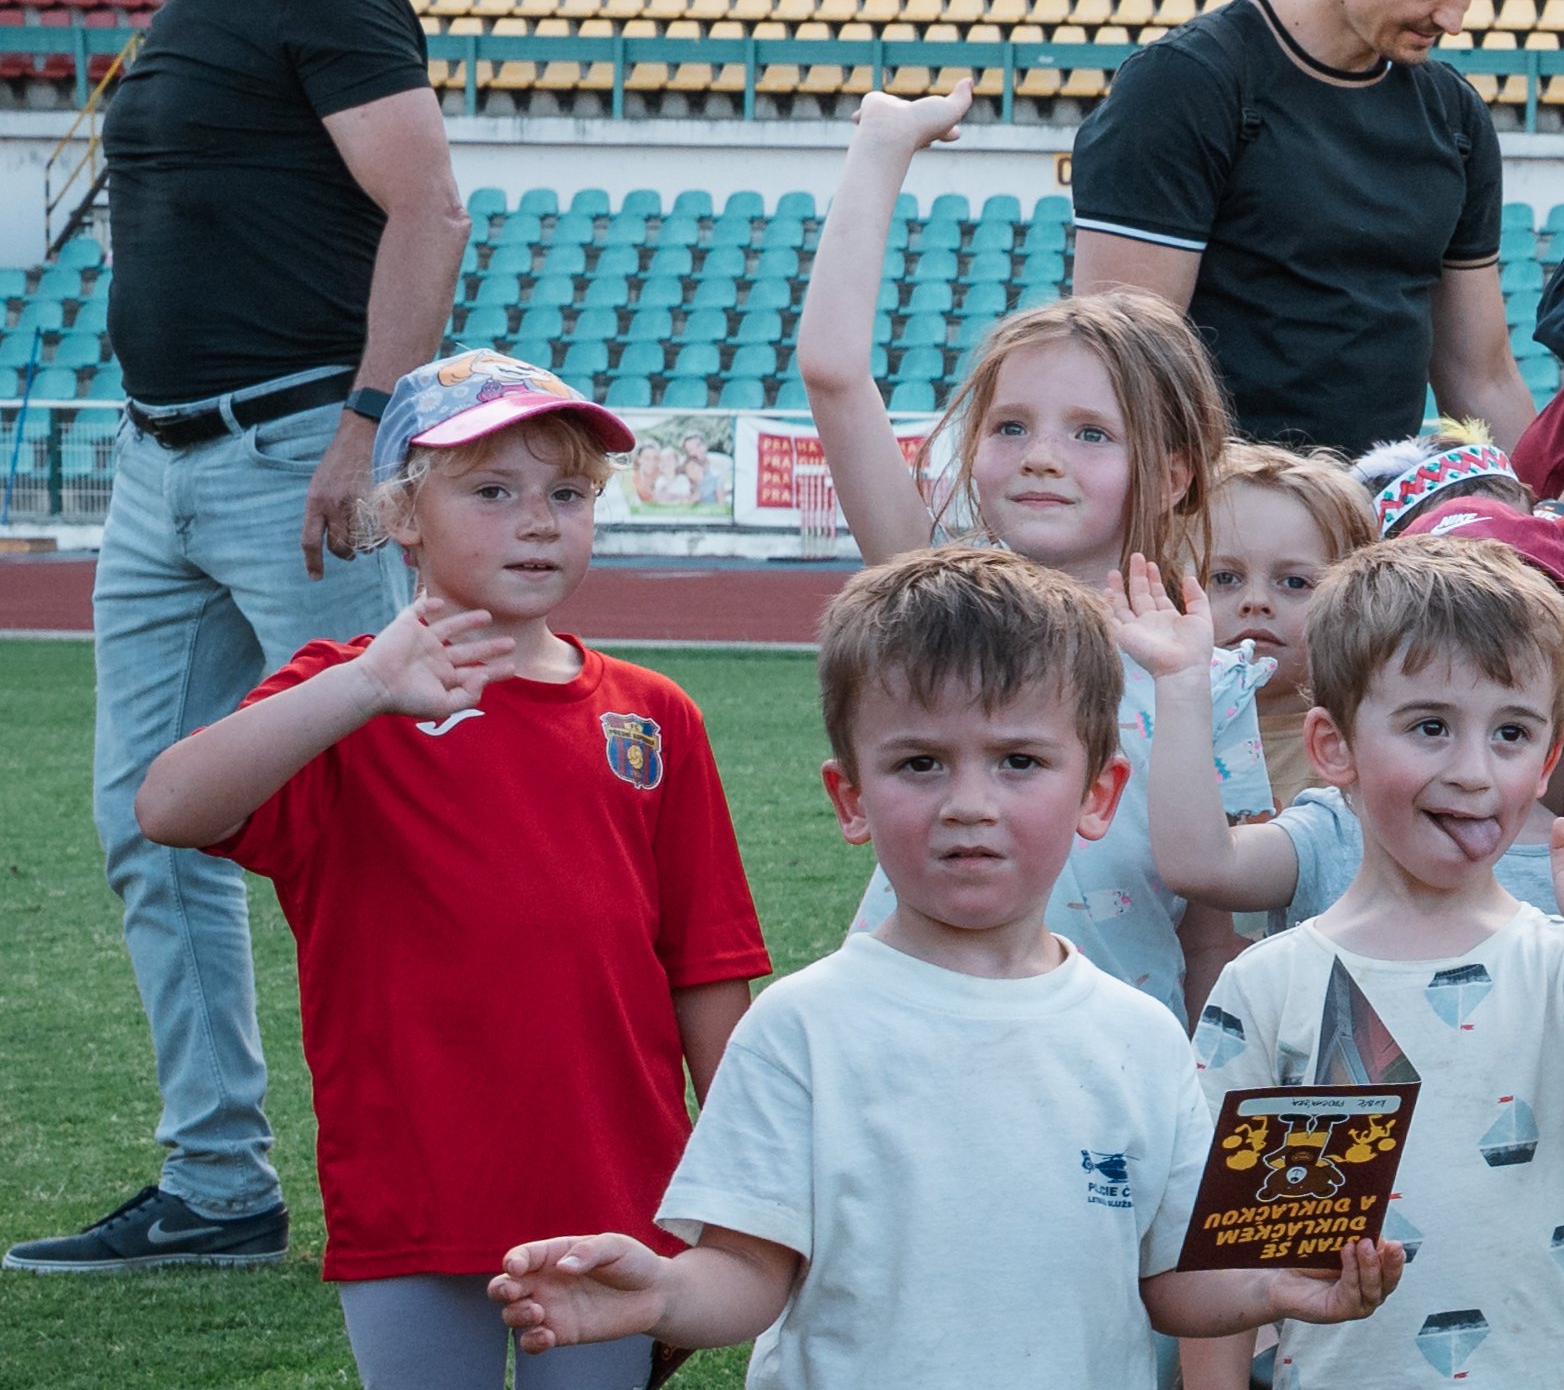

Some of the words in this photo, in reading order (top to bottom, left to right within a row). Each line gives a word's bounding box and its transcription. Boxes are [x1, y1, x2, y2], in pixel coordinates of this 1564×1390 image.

[1440, 513, 1478, 529] NIKE
[1360, 1195, 1377, 1211] A
[1204, 1198, 1352, 1230] DUKLÁČKOU
[1215, 1215, 1368, 1247] DUKLÁČKEM
[1259, 1240, 1293, 1260] SE
